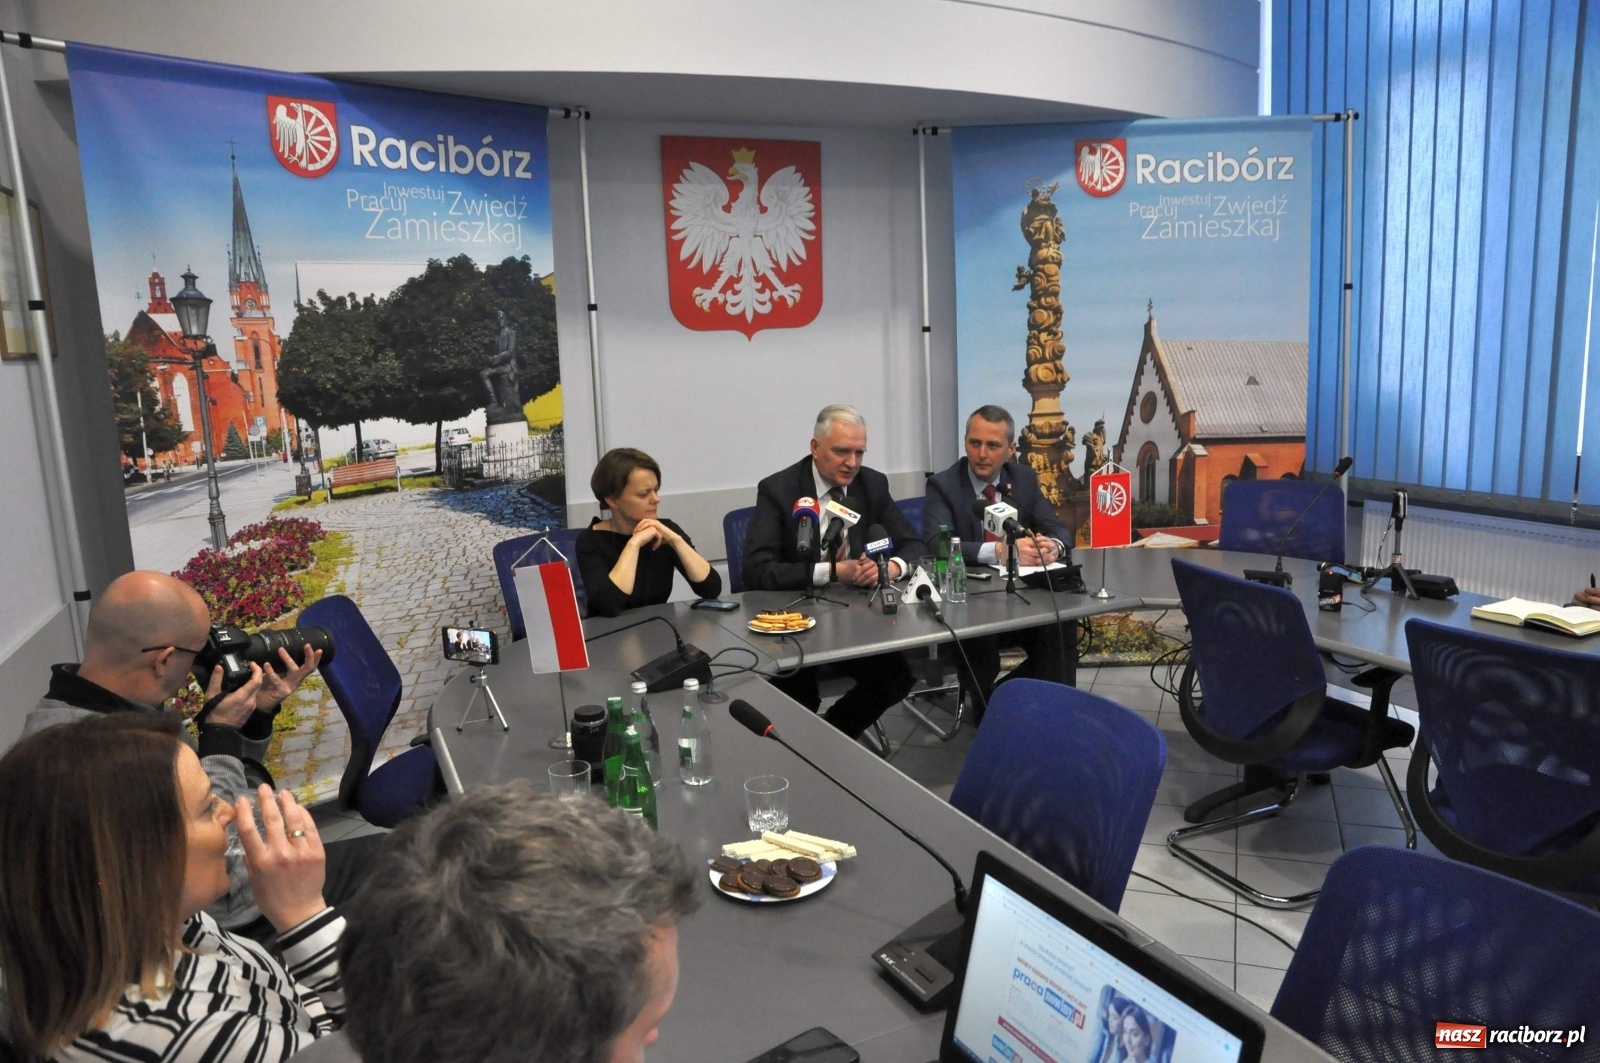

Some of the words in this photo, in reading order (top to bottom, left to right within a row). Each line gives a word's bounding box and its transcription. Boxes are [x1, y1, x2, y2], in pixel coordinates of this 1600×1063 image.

[350, 125, 532, 179] Racibórz
[1136, 146, 1294, 184] Racibórz
[346, 188, 407, 215] Pracuj
[383, 181, 444, 203] Inwestuj
[447, 191, 528, 219] Zwiedź
[1159, 193, 1211, 207] Inwestuj
[1213, 194, 1288, 216] Zwiedź
[1129, 202, 1178, 219] Pracuj
[364, 207, 522, 250] Zamieszkaj
[1142, 213, 1280, 241] Zamieszkaj
[1013, 968, 1044, 996] praca
